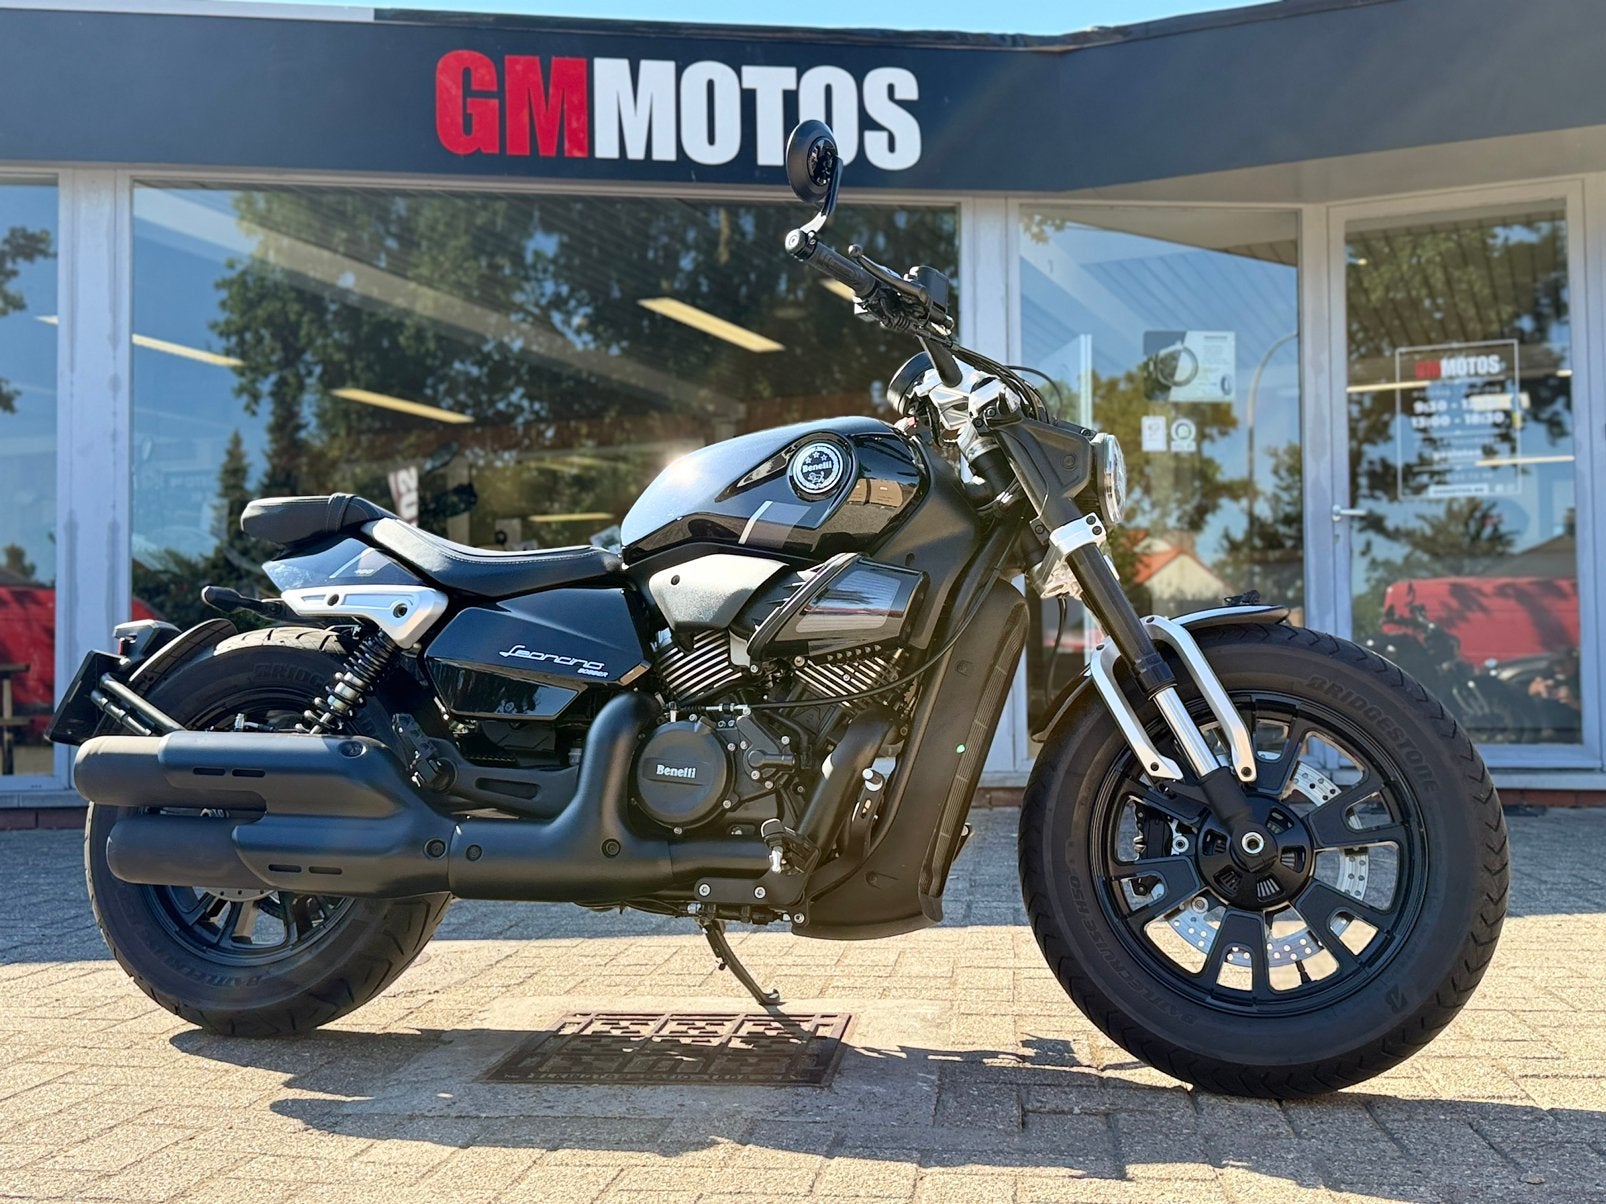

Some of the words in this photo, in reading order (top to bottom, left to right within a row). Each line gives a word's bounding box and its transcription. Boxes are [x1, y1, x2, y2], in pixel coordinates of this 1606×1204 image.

[435, 50, 922, 171] GMMOTOS
[802, 460, 832, 473] Benelli
[1305, 674, 1442, 794] BRIDGESTONE
[656, 764, 697, 779] Benelli
